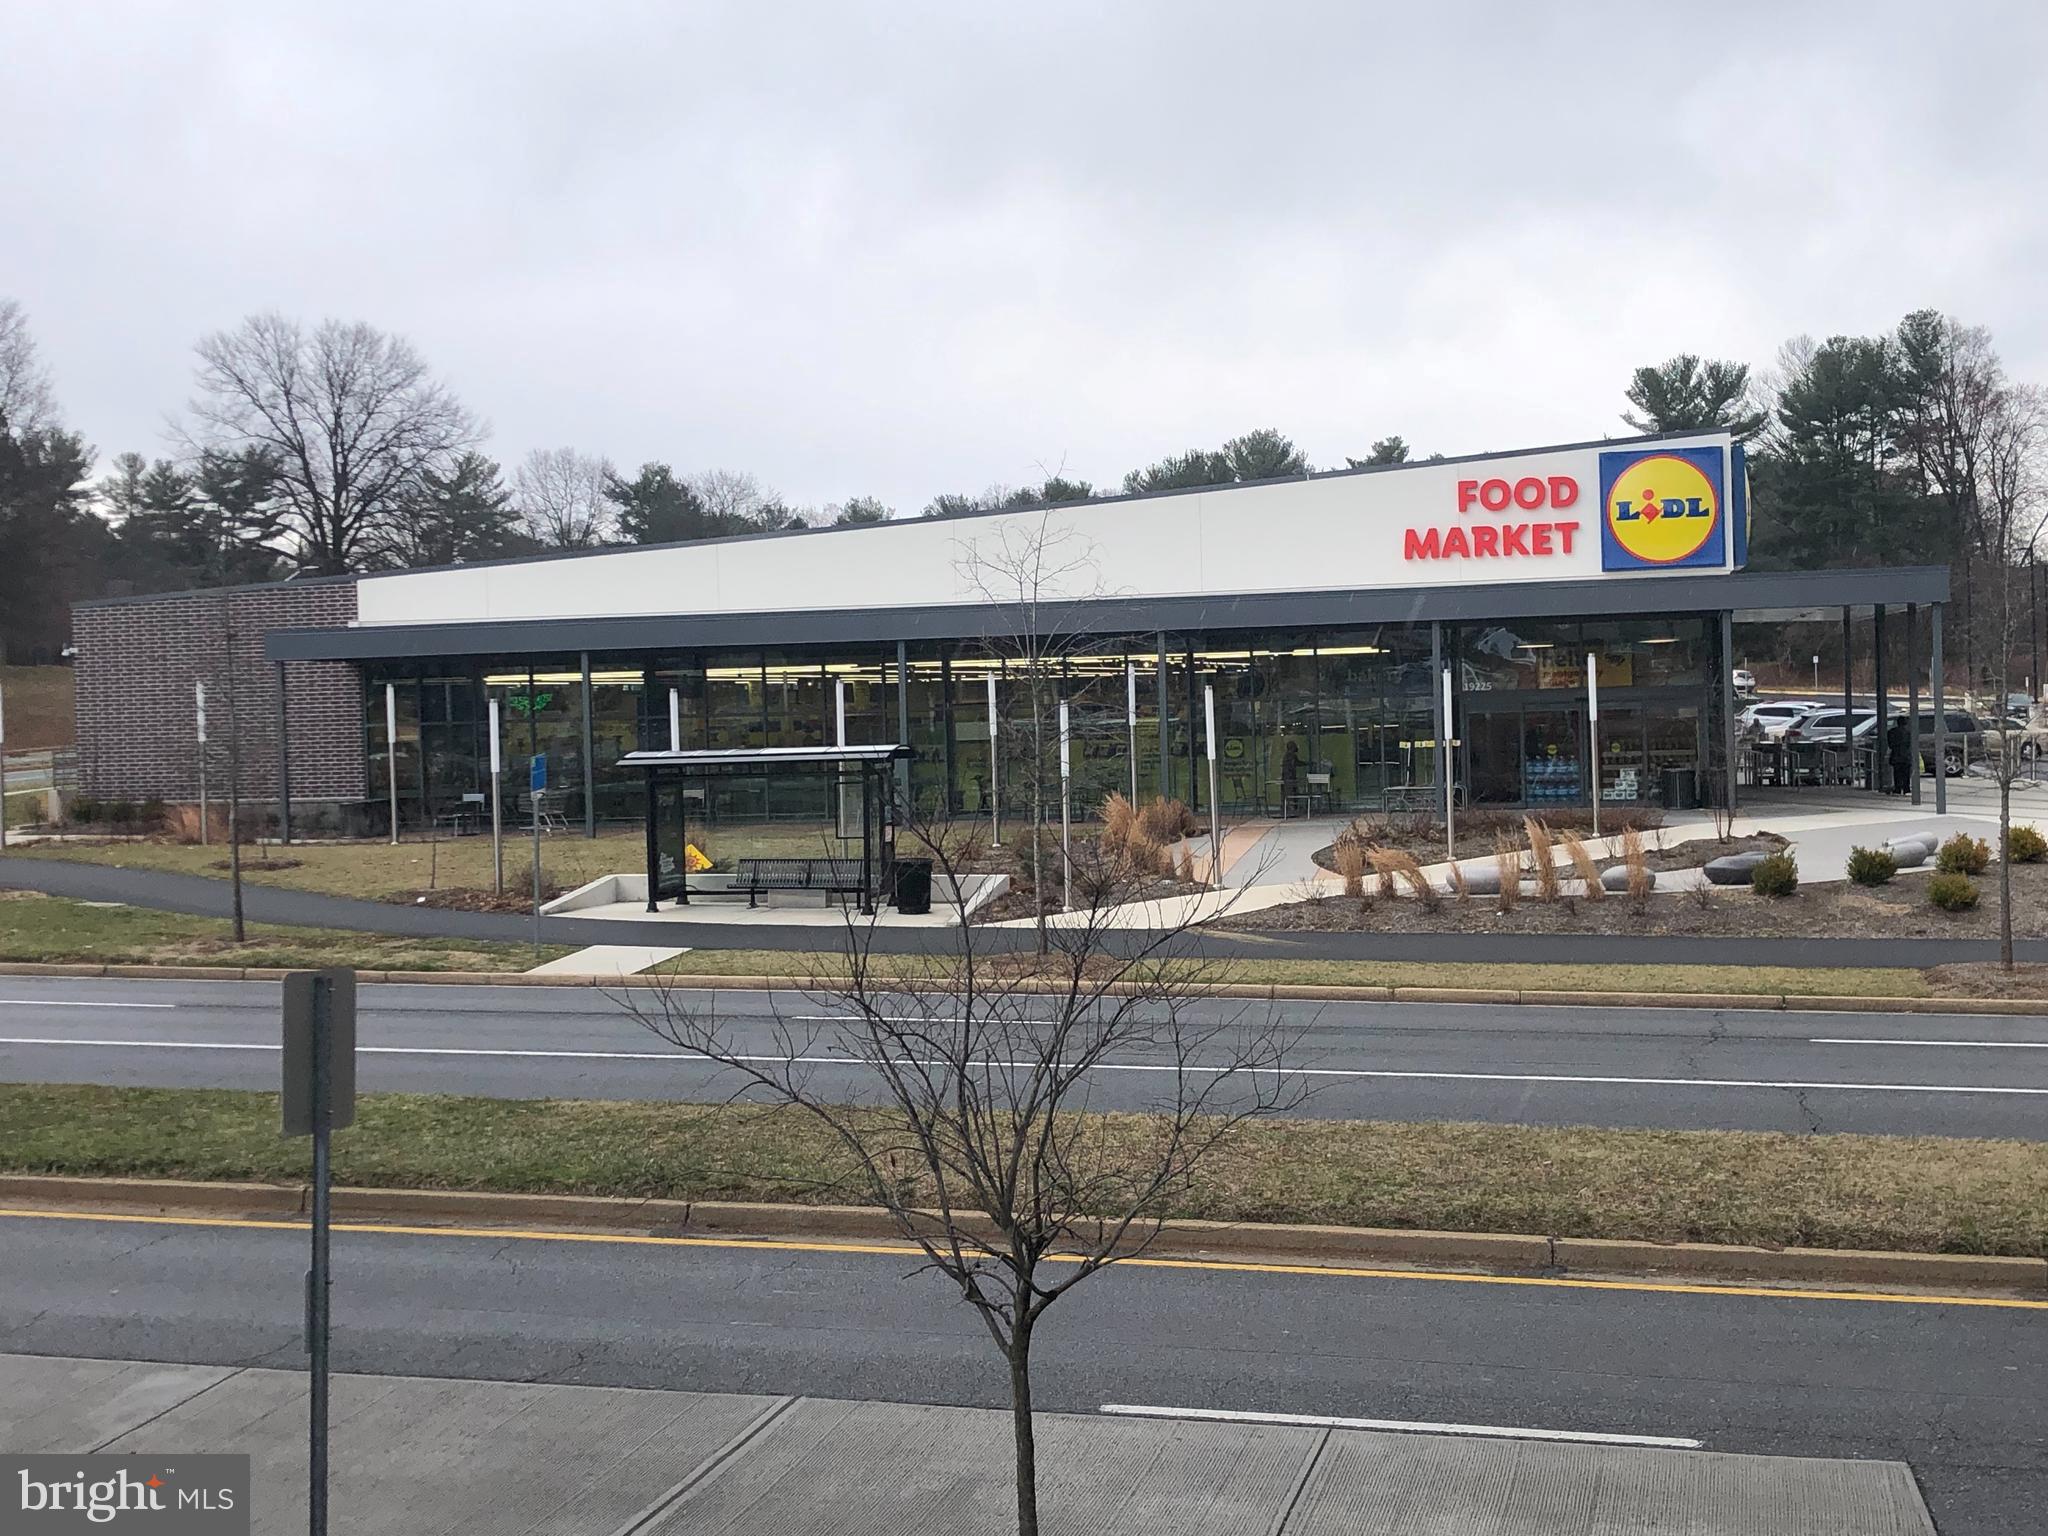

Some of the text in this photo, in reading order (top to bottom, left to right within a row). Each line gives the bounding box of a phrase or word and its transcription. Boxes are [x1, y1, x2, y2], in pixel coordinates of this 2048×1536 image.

[1457, 475, 1580, 513] FOOD
[1403, 521, 1580, 561] MARKET
[1463, 682, 1493, 692] 19225
